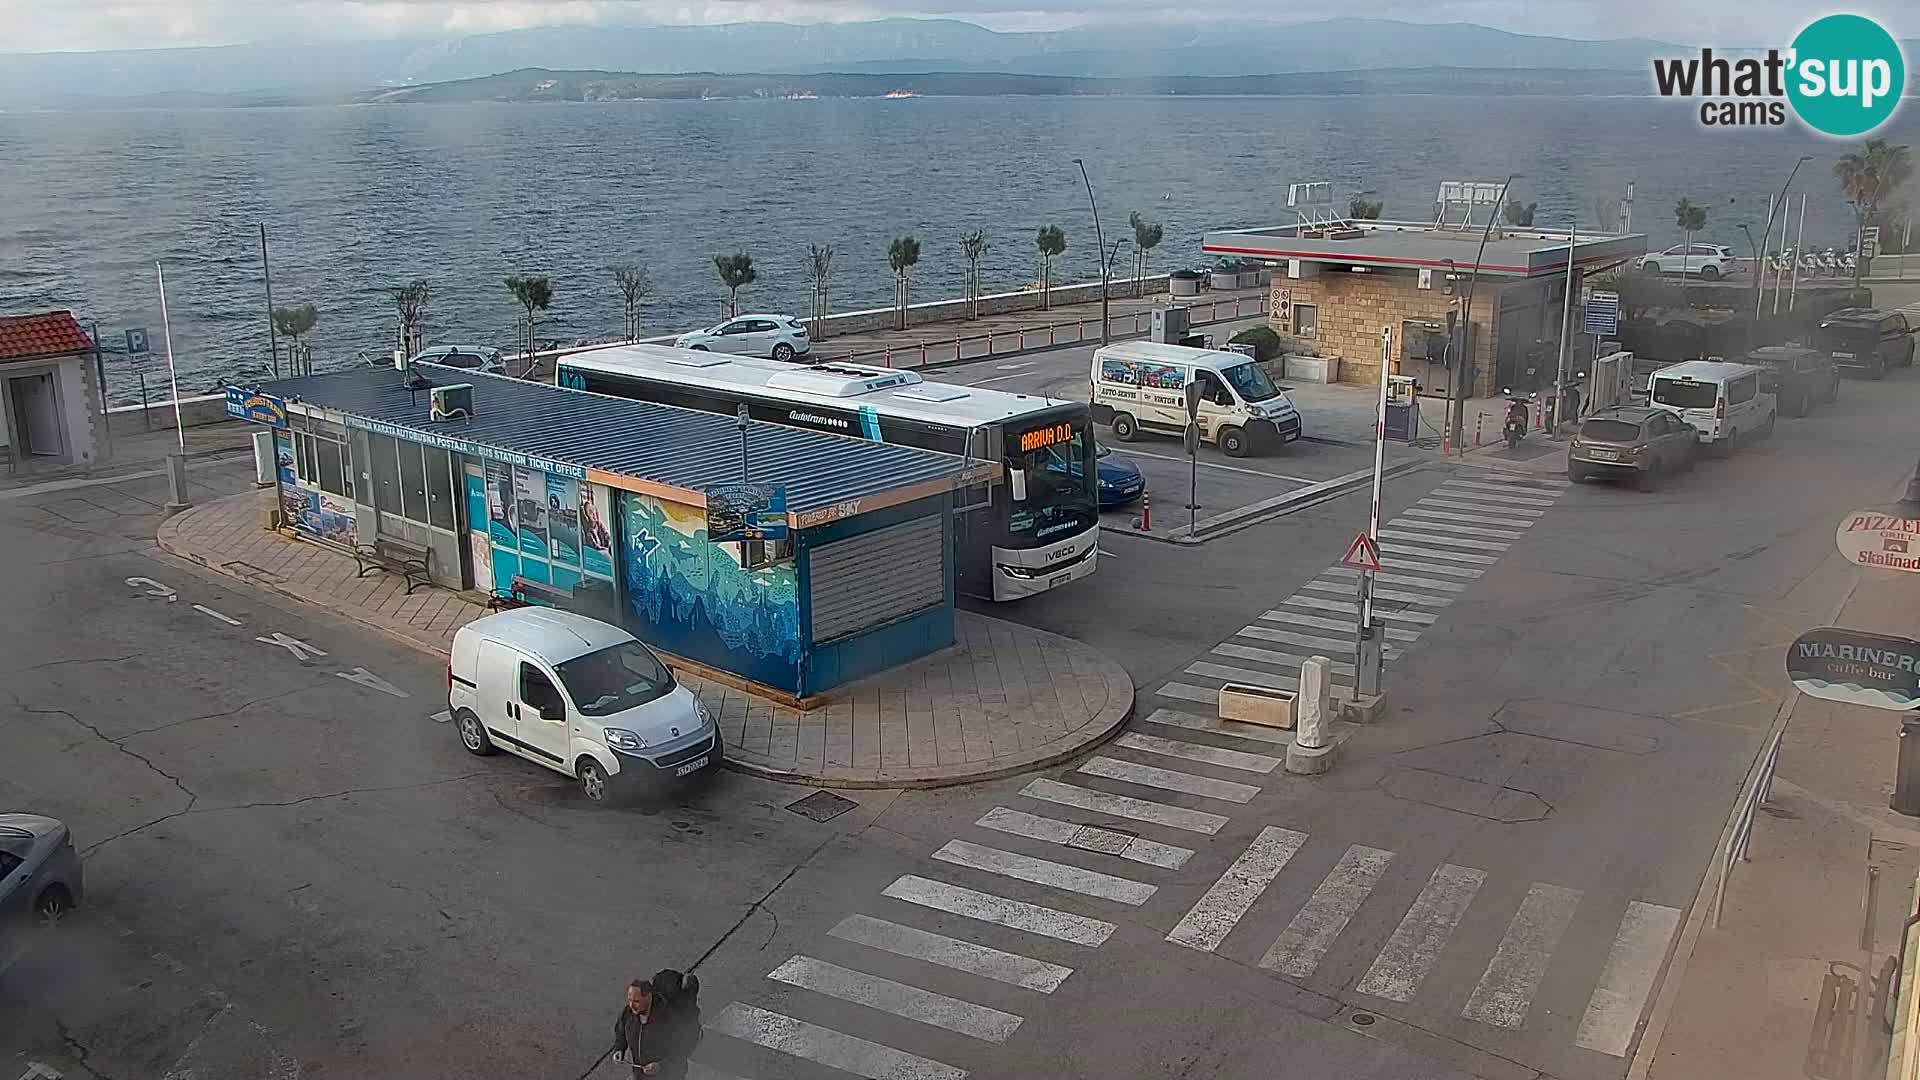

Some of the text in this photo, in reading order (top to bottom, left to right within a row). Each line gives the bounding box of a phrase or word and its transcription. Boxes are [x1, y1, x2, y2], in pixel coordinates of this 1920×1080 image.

[131, 331, 144, 350] P
[1021, 427, 1055, 452] ARRIVA
[396, 429, 436, 446] AUTOBUSNA
[436, 437, 468, 453] POSTAJA
[478, 446, 493, 458] BUS
[494, 450, 527, 465] STATION
[528, 457, 554, 471] TICKET
[555, 463, 583, 478] OFFICE
[1846, 516, 1920, 534] PIZZE
[1045, 545, 1075, 562] IVECO
[1868, 667, 1896, 680] bar
